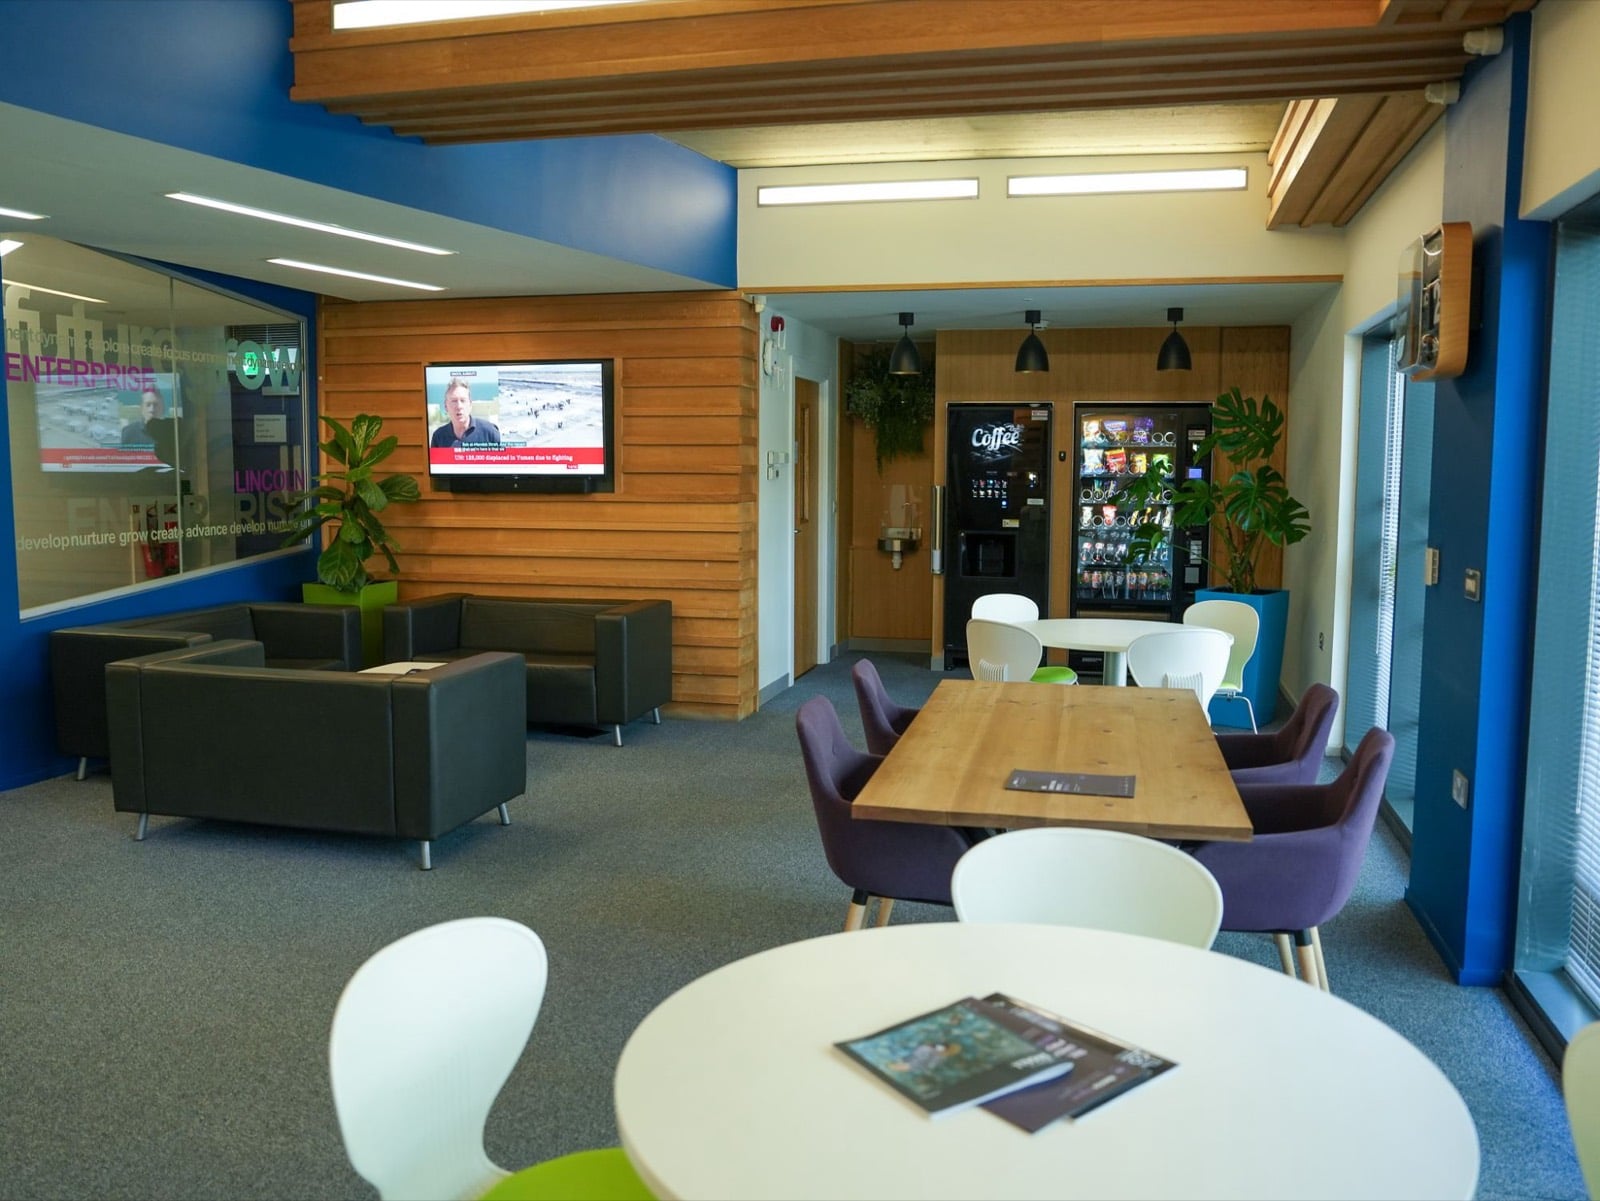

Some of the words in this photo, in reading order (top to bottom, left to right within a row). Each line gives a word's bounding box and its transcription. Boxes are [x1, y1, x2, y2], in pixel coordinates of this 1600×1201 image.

[5, 352, 156, 393] ENTERPRISE
[971, 426, 1020, 451] Coffee
[235, 469, 305, 492] LINCOLN
[16, 533, 70, 551] develop
[71, 531, 116, 546] nurture
[119, 531, 148, 547] grow
[151, 526, 183, 541] create
[186, 523, 227, 539] advance
[229, 520, 266, 536] develop
